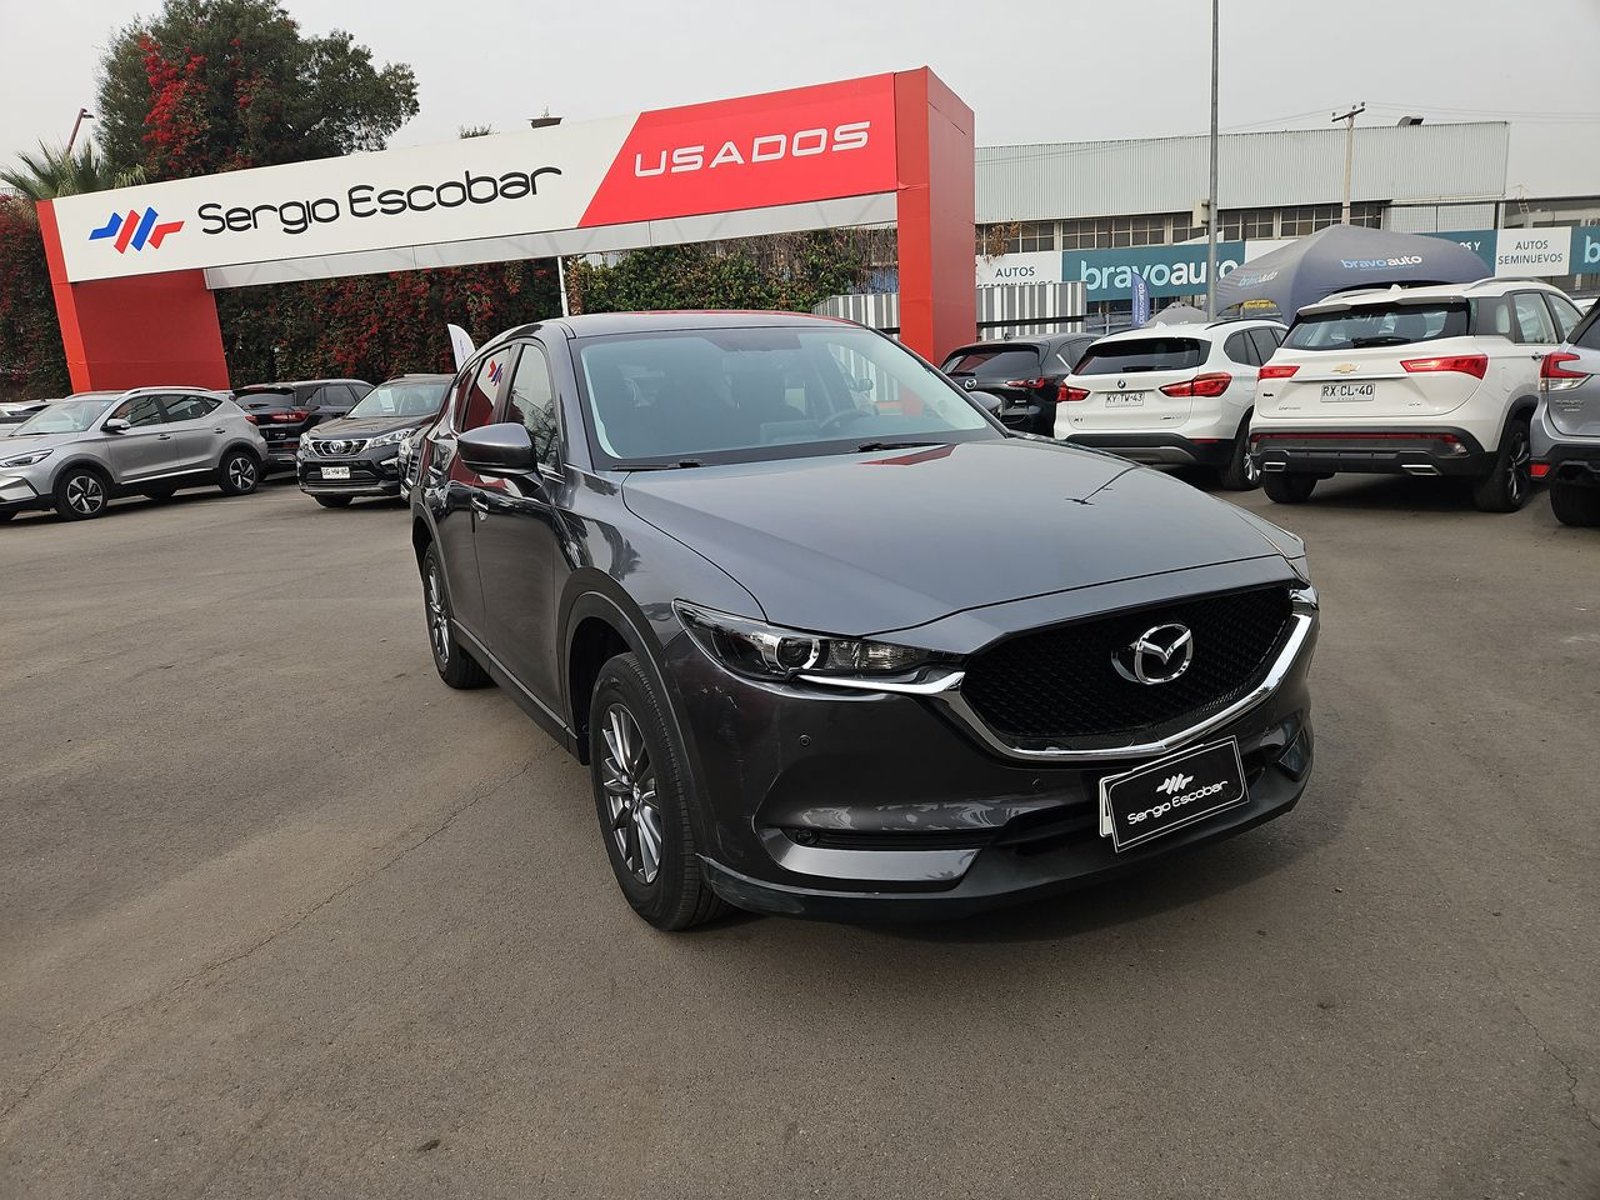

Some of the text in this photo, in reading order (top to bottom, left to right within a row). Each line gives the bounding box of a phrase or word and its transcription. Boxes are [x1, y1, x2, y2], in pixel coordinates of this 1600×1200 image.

[634, 121, 871, 177] USADOS
[197, 166, 562, 234] Sergio Escobar
[1515, 240, 1549, 250] AUTOS
[1341, 255, 1422, 268] bravoauto
[1498, 253, 1563, 265] SEMINUEVOS
[995, 266, 1035, 277] AUTOS
[1172, 780, 1228, 808] Escobar
